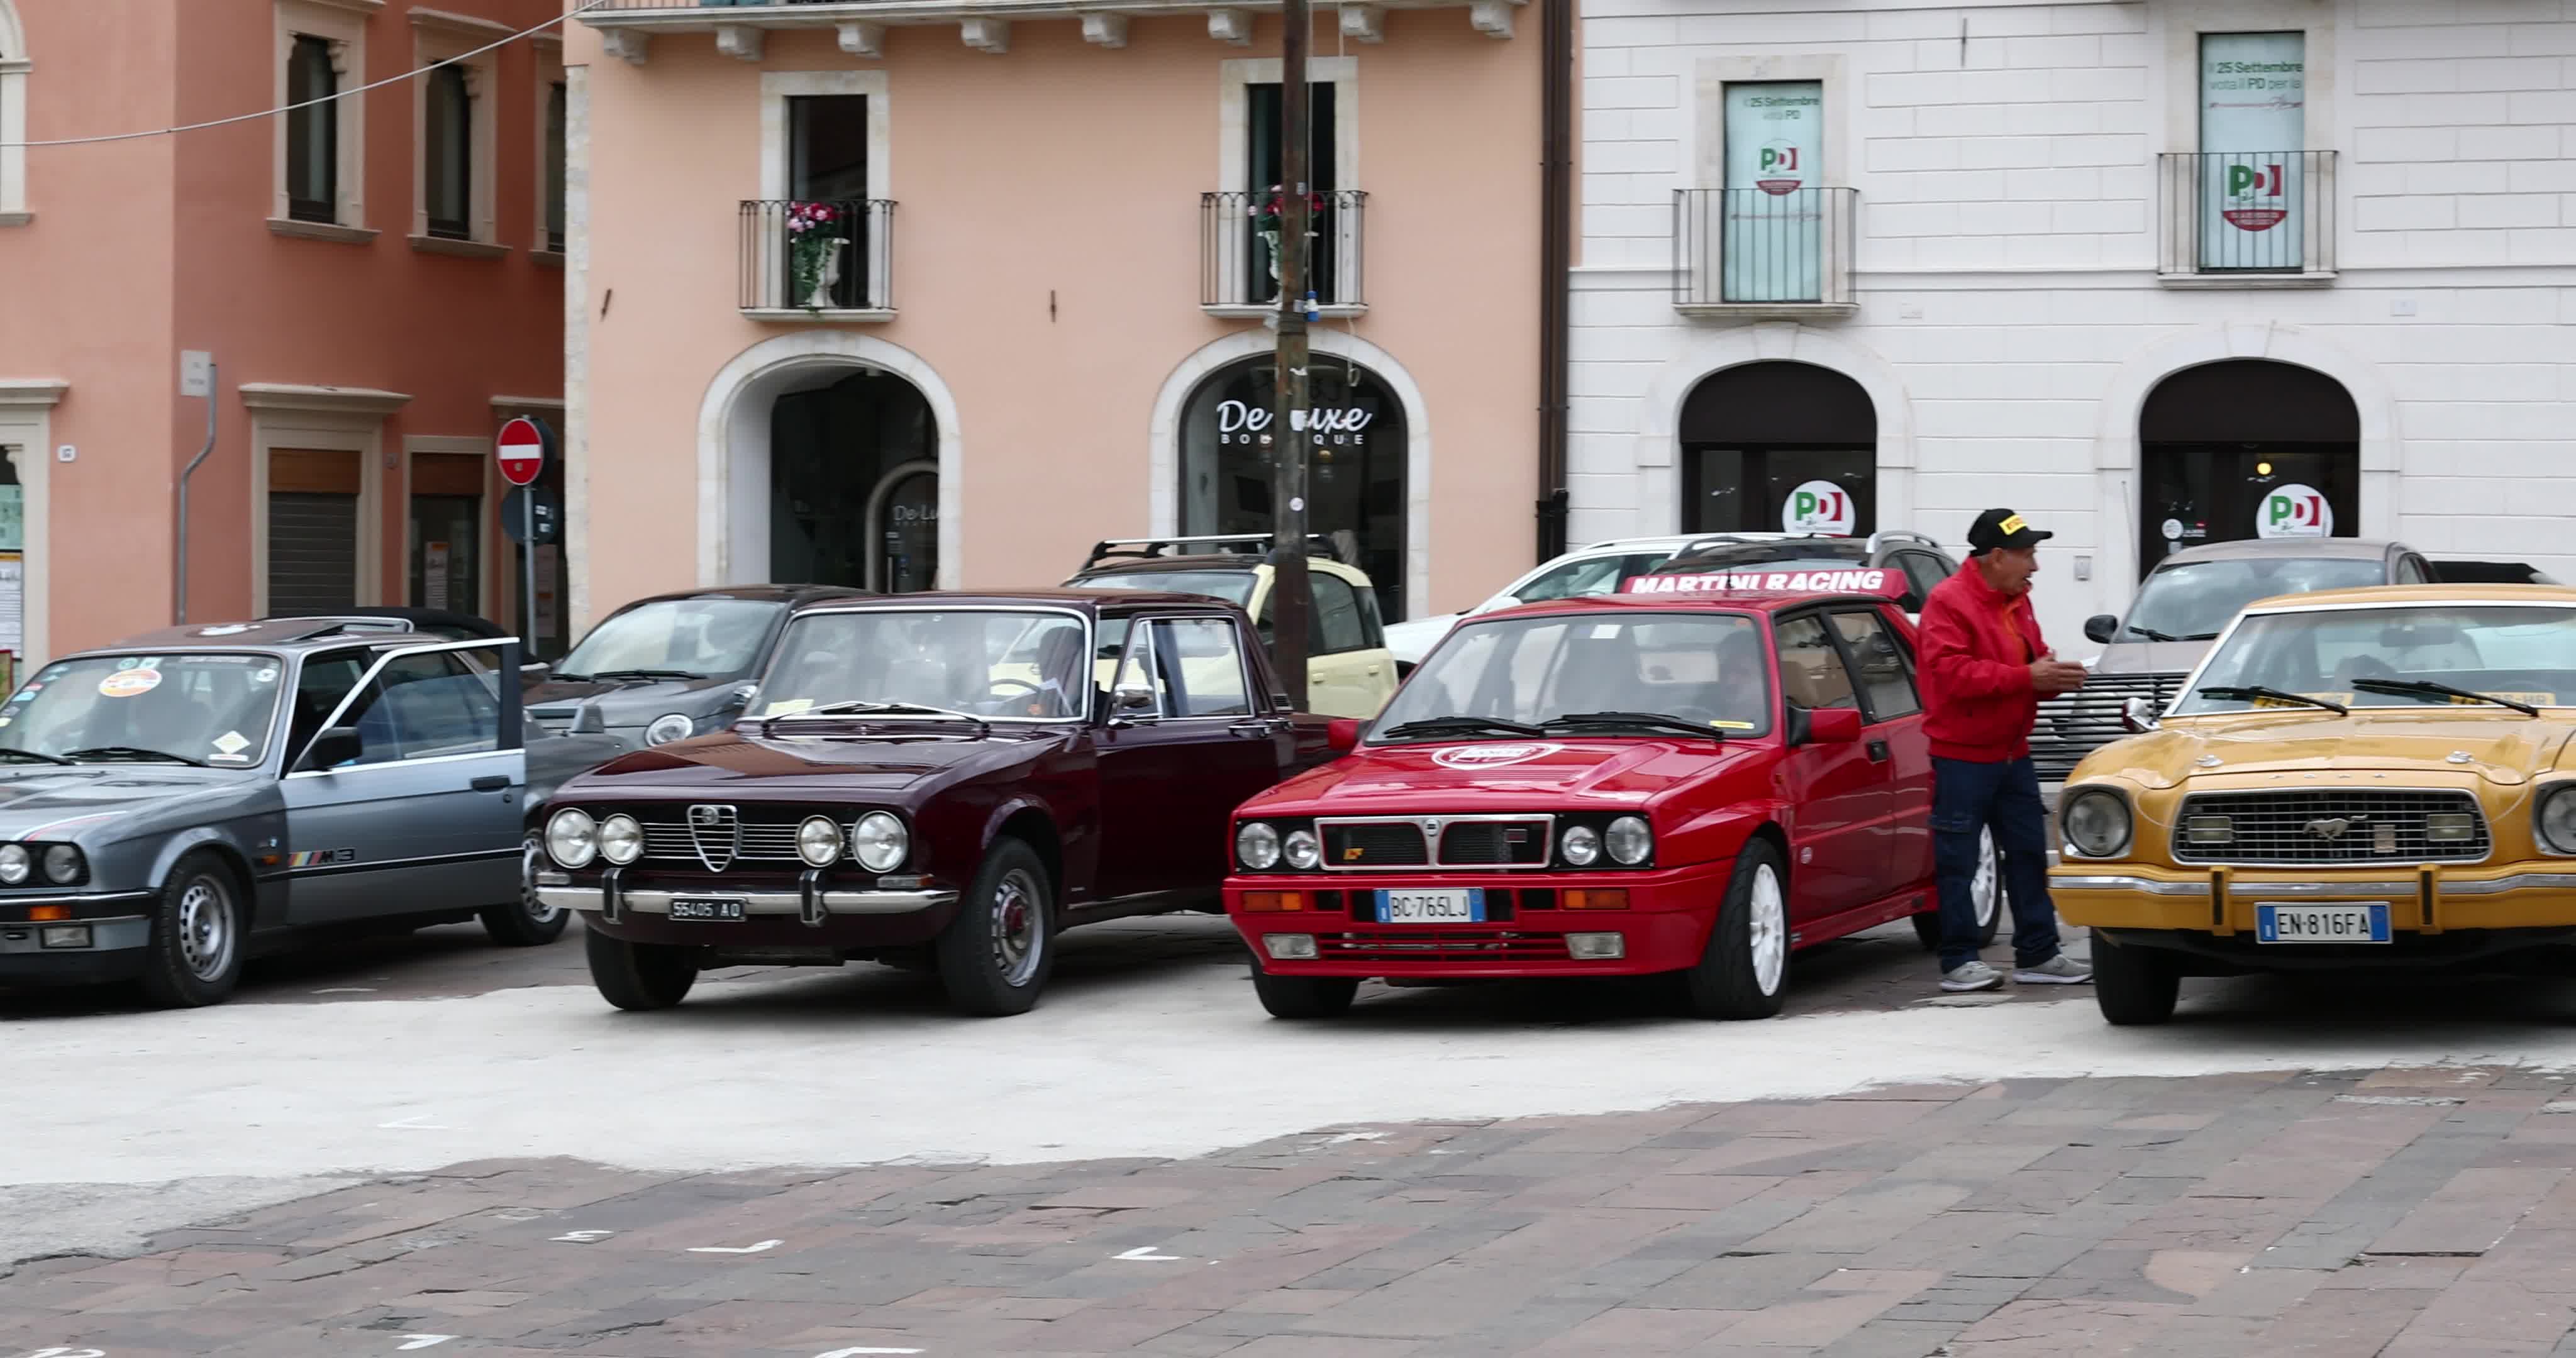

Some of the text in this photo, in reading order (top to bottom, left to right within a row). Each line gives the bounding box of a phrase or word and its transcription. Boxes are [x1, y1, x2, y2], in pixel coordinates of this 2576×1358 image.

[2216, 62, 2232, 74] 25
[2234, 60, 2303, 74] Settembre
[2248, 77, 2265, 89] PD
[1750, 97, 1763, 107] 25
[1760, 148, 1797, 170] PD
[2229, 165, 2282, 196] PD
[1216, 400, 1373, 434] De uxe
[1796, 492, 1842, 521] PD
[2269, 495, 2320, 526] PD
[1631, 571, 1884, 593] MARTINI RACING
[673, 901, 714, 917] 55405
